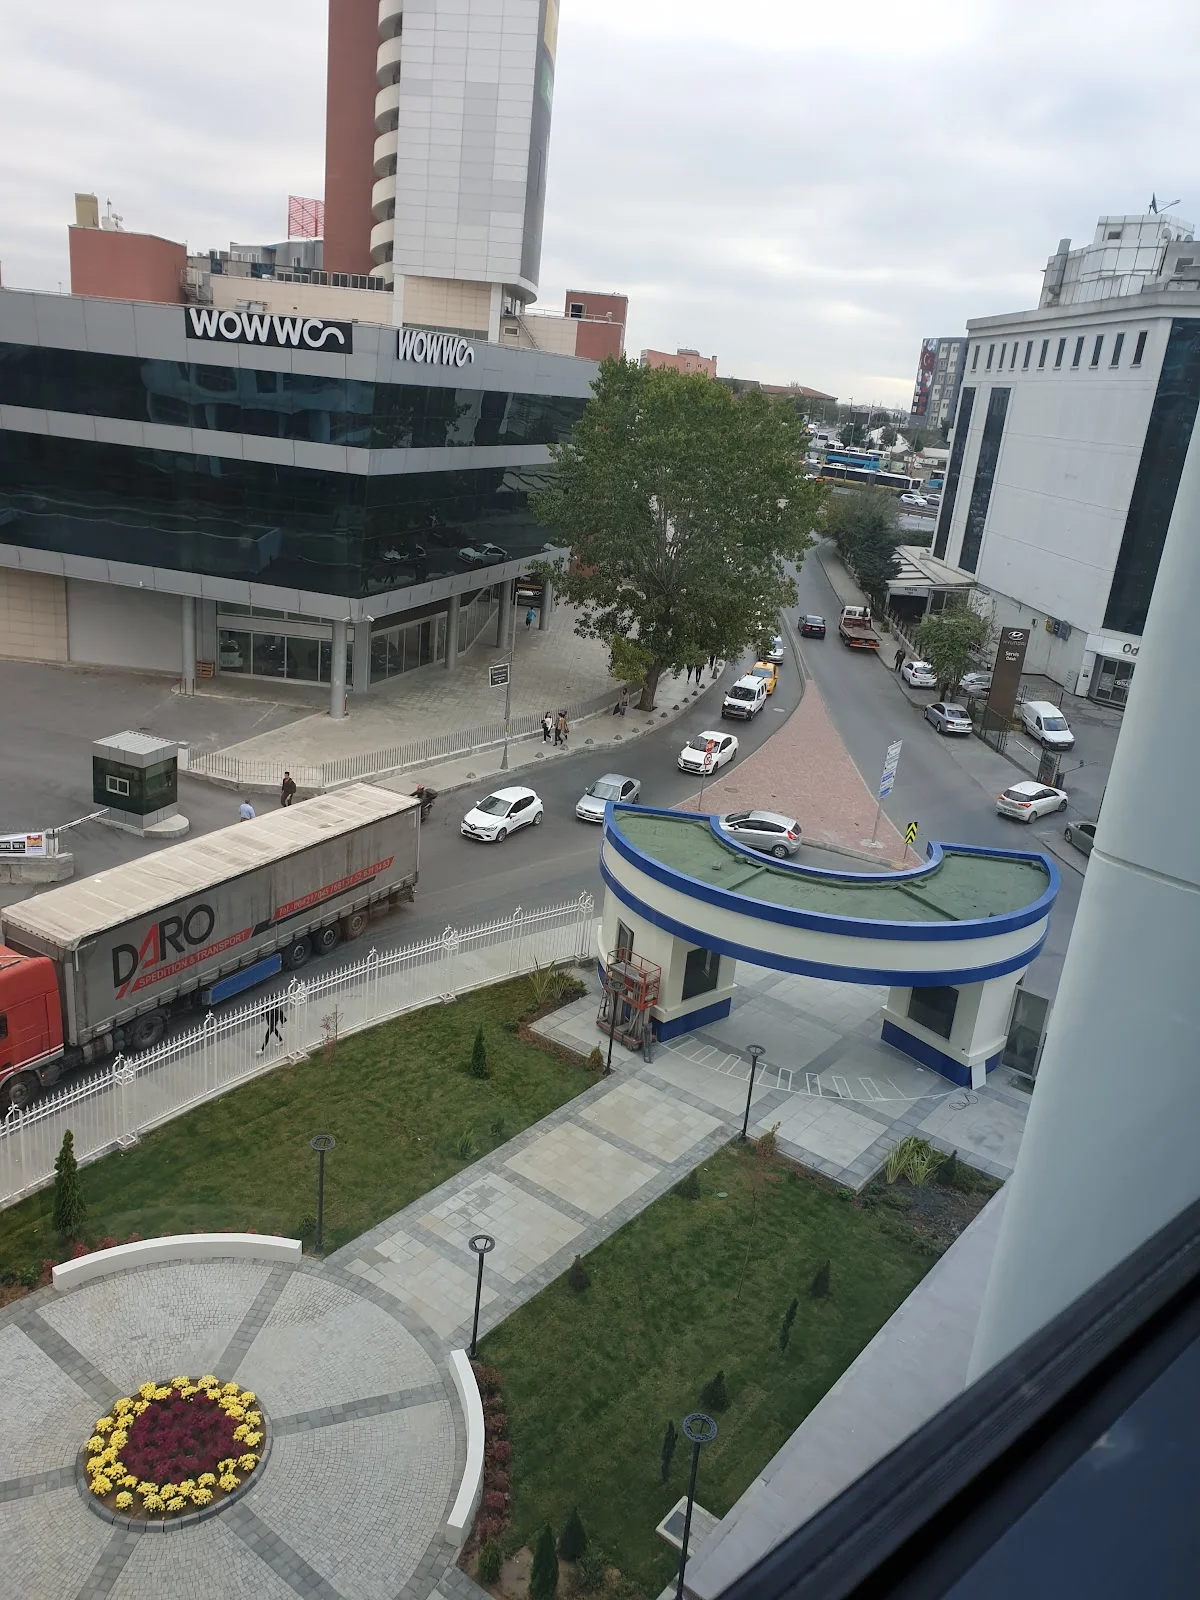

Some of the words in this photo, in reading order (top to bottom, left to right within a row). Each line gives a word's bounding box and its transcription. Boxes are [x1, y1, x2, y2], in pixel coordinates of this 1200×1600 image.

[111, 903, 215, 1000] DARO
[139, 959, 188, 987] SPEDITION
[196, 932, 247, 961] TRANSPORT
